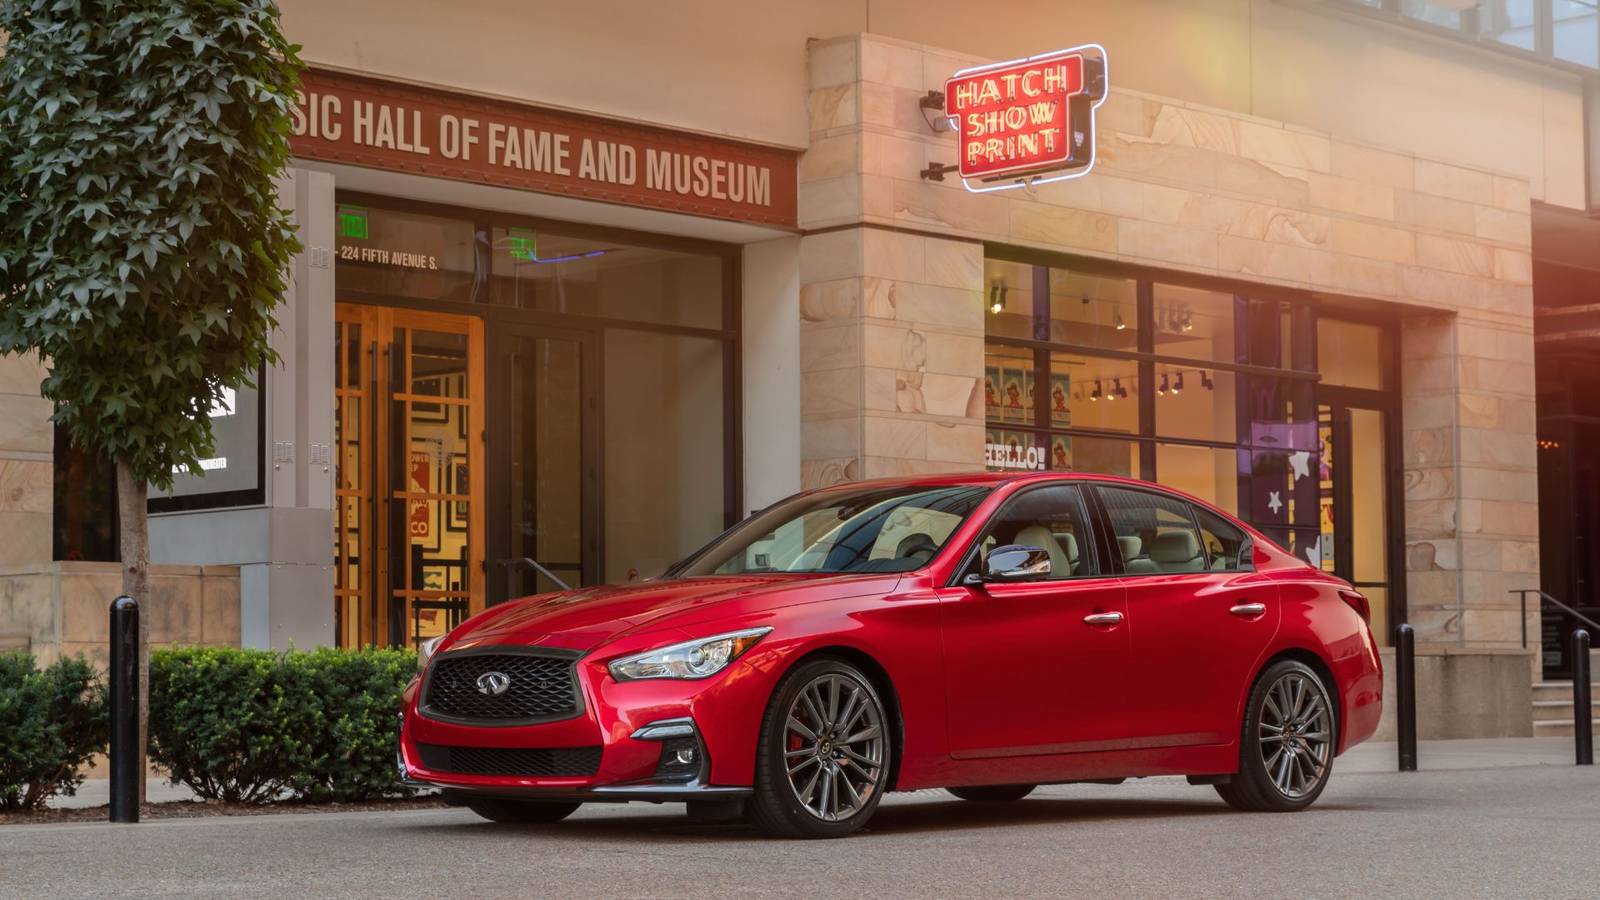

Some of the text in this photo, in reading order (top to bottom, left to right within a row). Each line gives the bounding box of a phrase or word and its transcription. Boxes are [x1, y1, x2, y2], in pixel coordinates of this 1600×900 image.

[956, 64, 1067, 110] HATCH
[966, 101, 1058, 136] SHOW
[353, 100, 430, 154] HALL
[439, 114, 479, 160] OF
[488, 122, 571, 176] FAME
[578, 138, 637, 186] AND
[645, 149, 771, 206] MUSEUM
[967, 128, 1060, 166] PRINT
[341, 245, 359, 260] 224
[362, 248, 389, 264] FIFTH
[391, 251, 427, 269] AVENUE
[428, 256, 438, 270] S.
[985, 443, 1046, 470] HELLO!
